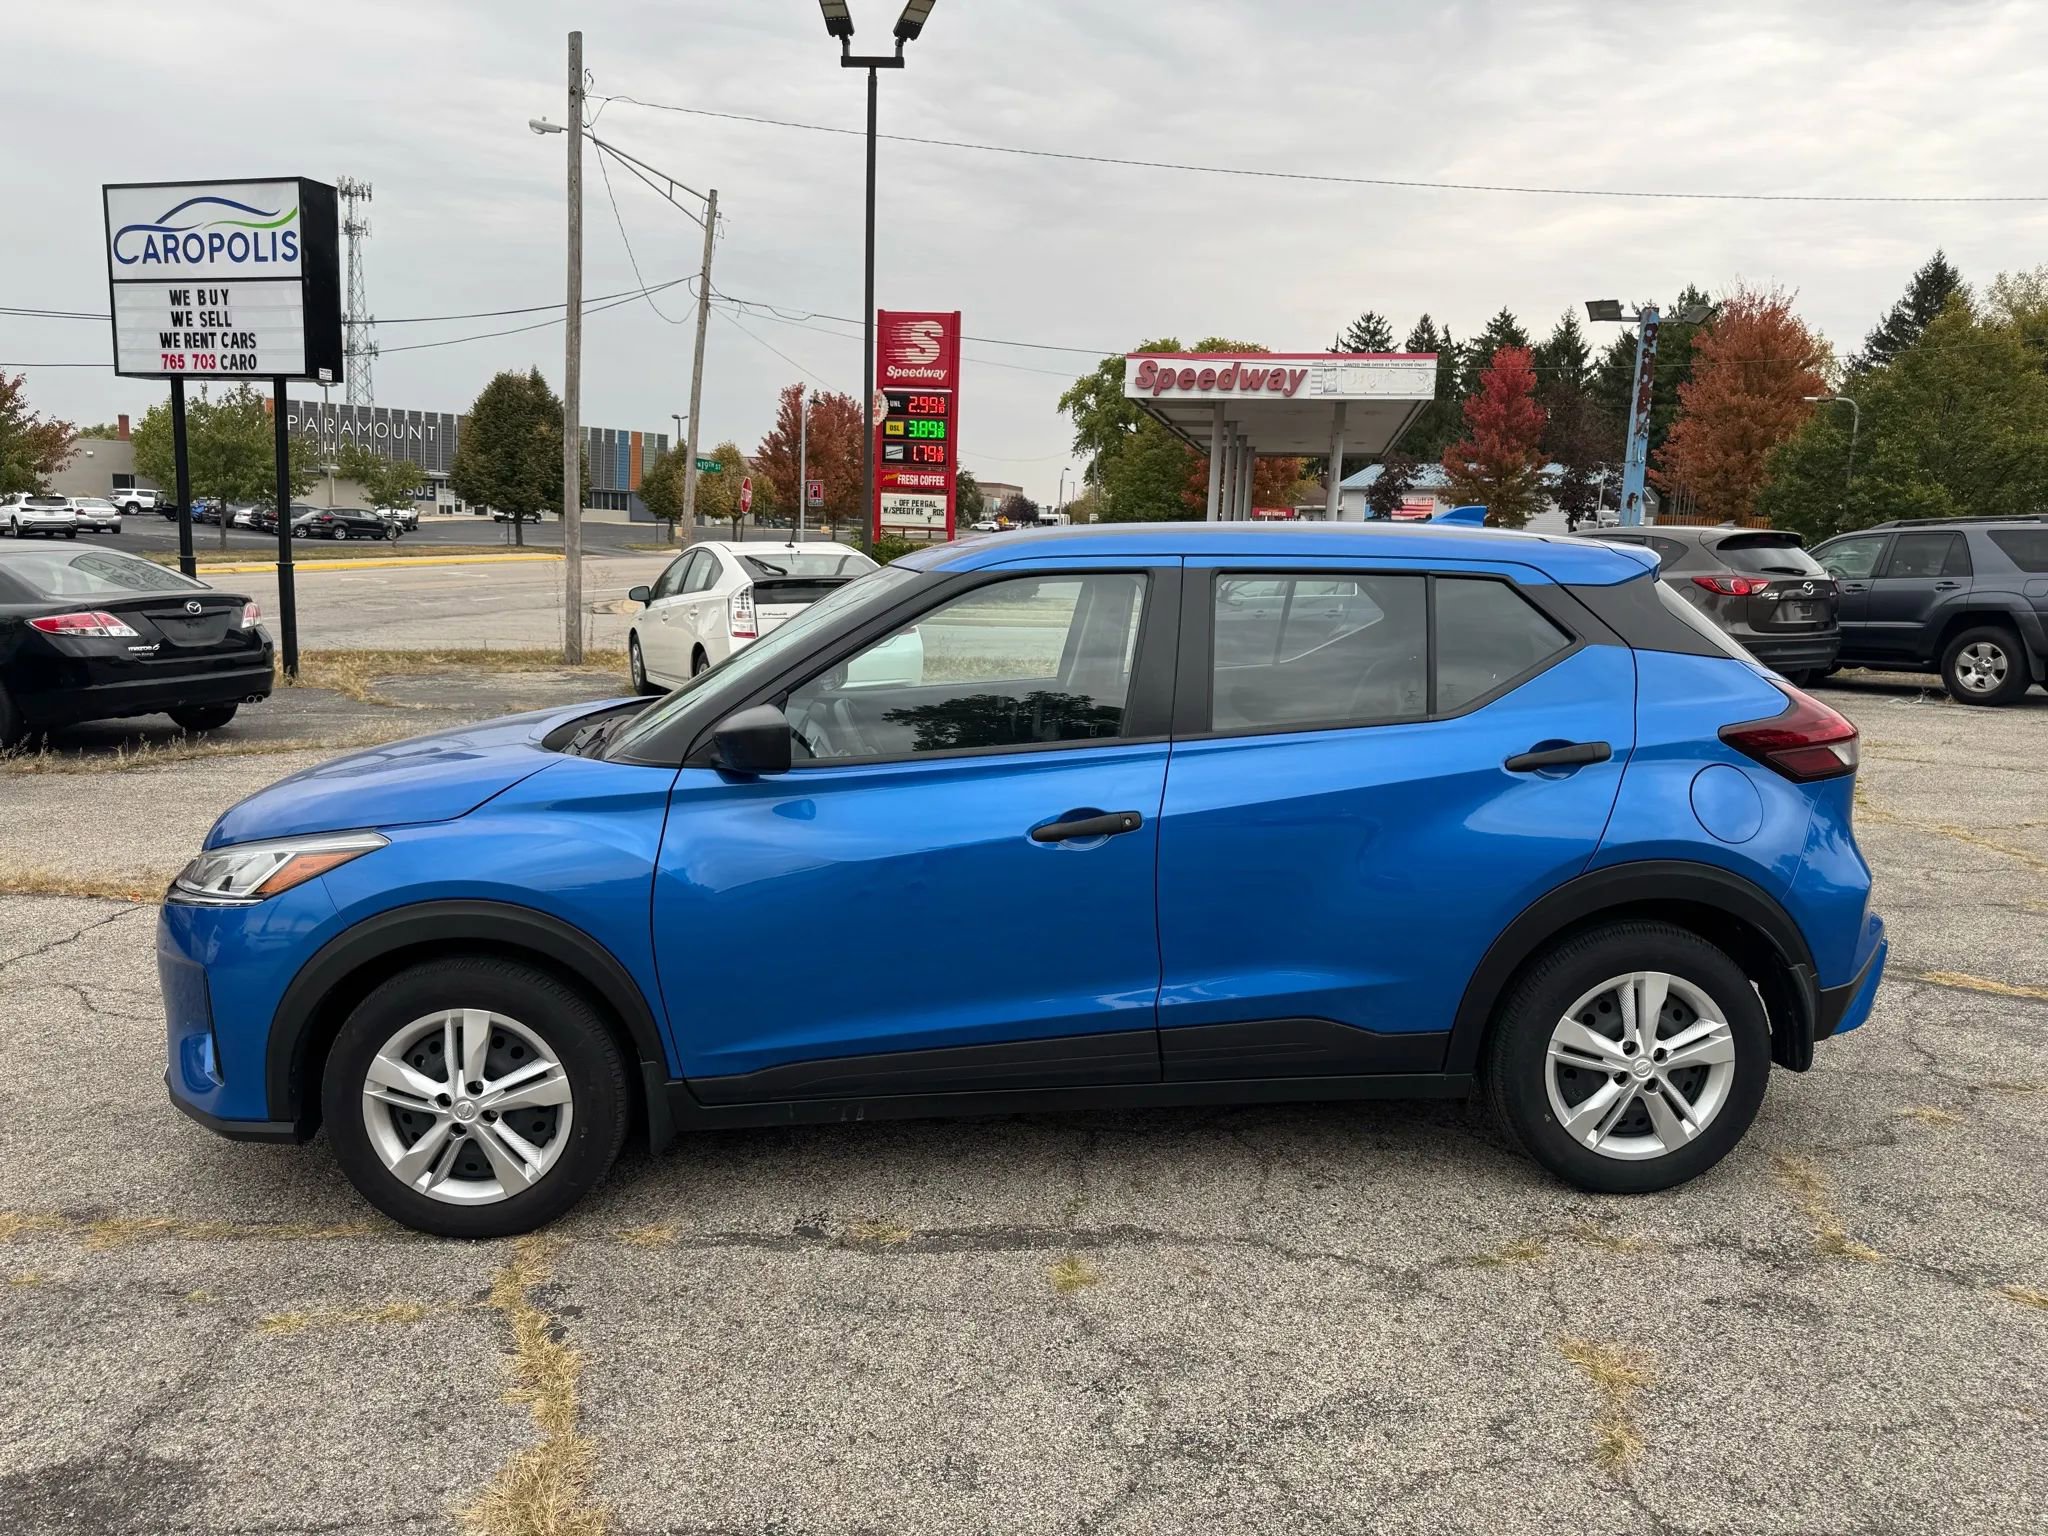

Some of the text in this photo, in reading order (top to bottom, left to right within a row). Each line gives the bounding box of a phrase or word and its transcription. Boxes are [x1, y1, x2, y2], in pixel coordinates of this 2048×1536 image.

[113, 225, 299, 264] CAROPOLIS
[169, 289, 229, 306] WE BUY
[171, 311, 232, 327] WE SELL
[159, 332, 256, 349] WE RENT CARS
[161, 354, 257, 370] 765 703 CARO
[886, 365, 947, 380] Speedway
[1135, 360, 1308, 397] Speedway
[909, 396, 937, 413] 2.99
[287, 414, 436, 441] PARAMOUNT
[889, 424, 900, 432] DSL
[909, 420, 937, 438] 3.89
[913, 445, 936, 462] 1.79
[897, 474, 918, 485] FRESH
[920, 475, 945, 486] COFFEE
